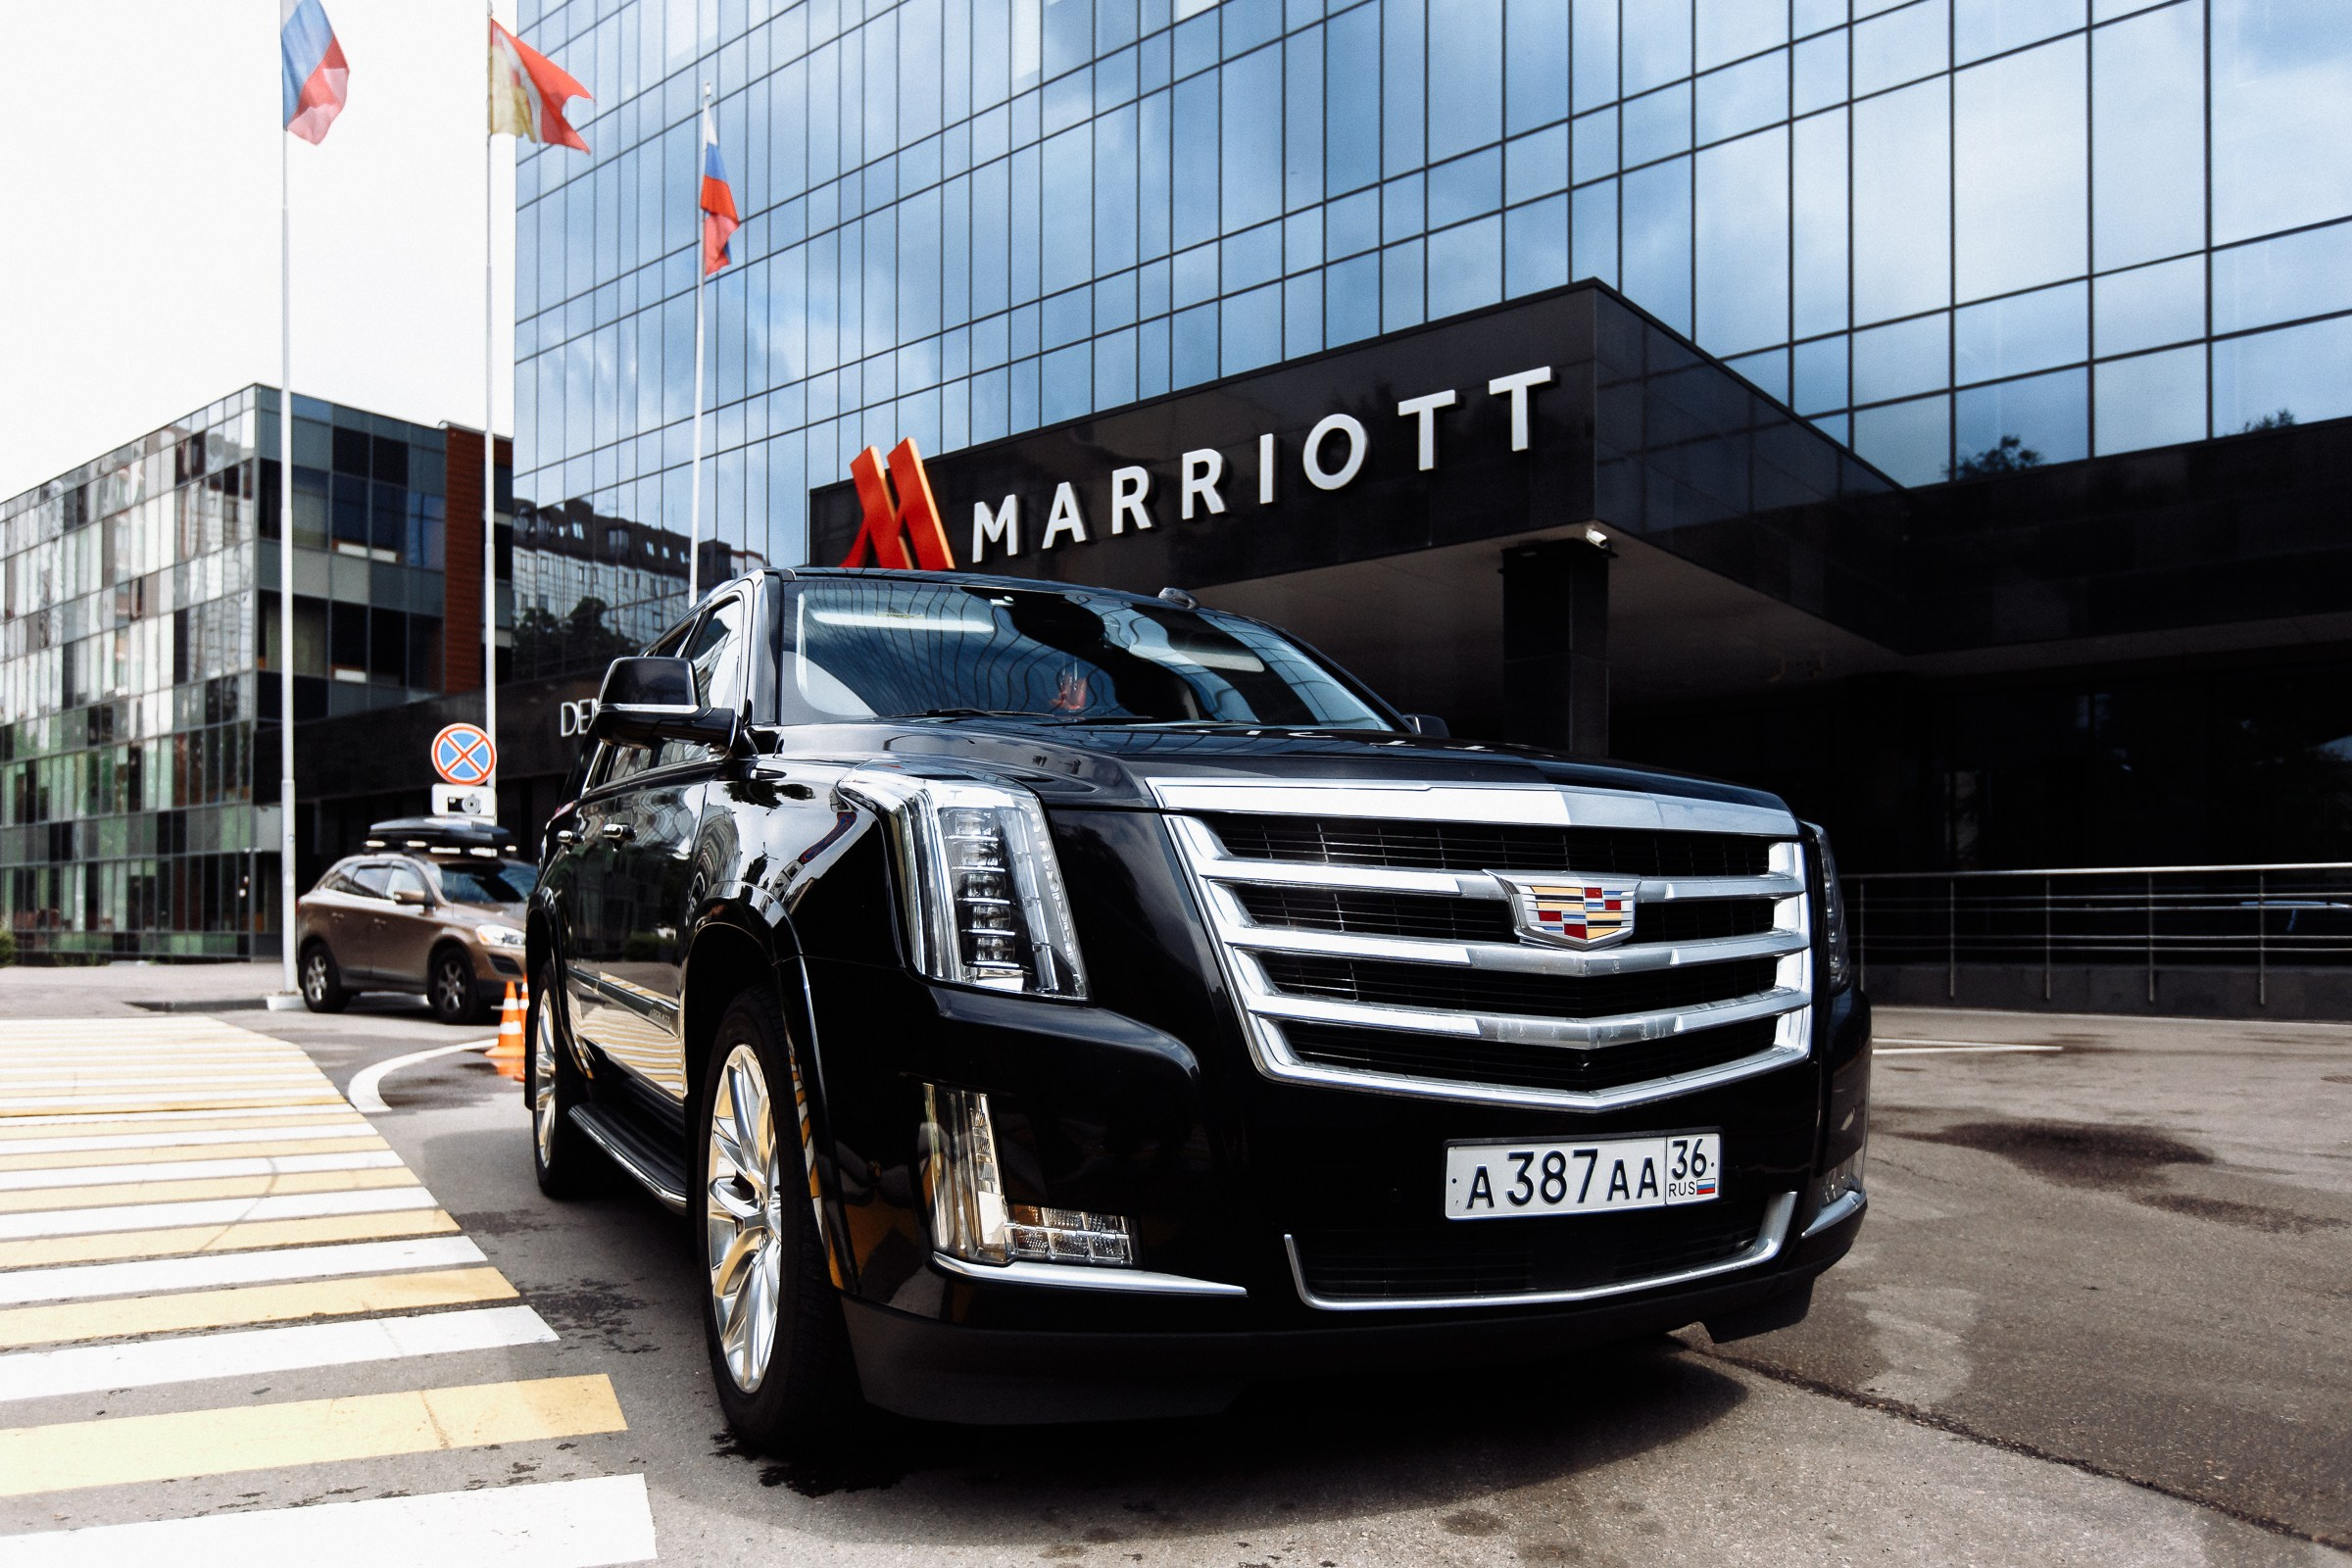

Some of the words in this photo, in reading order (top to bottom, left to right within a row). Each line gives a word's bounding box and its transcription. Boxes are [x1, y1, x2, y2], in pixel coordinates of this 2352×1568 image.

[972, 367, 1552, 564] MARRIOTT
[561, 698, 600, 737] DE
[1465, 1148, 1659, 1209] A387AA
[1671, 1138, 1707, 1180] 36
[1668, 1181, 1695, 1198] RUS
